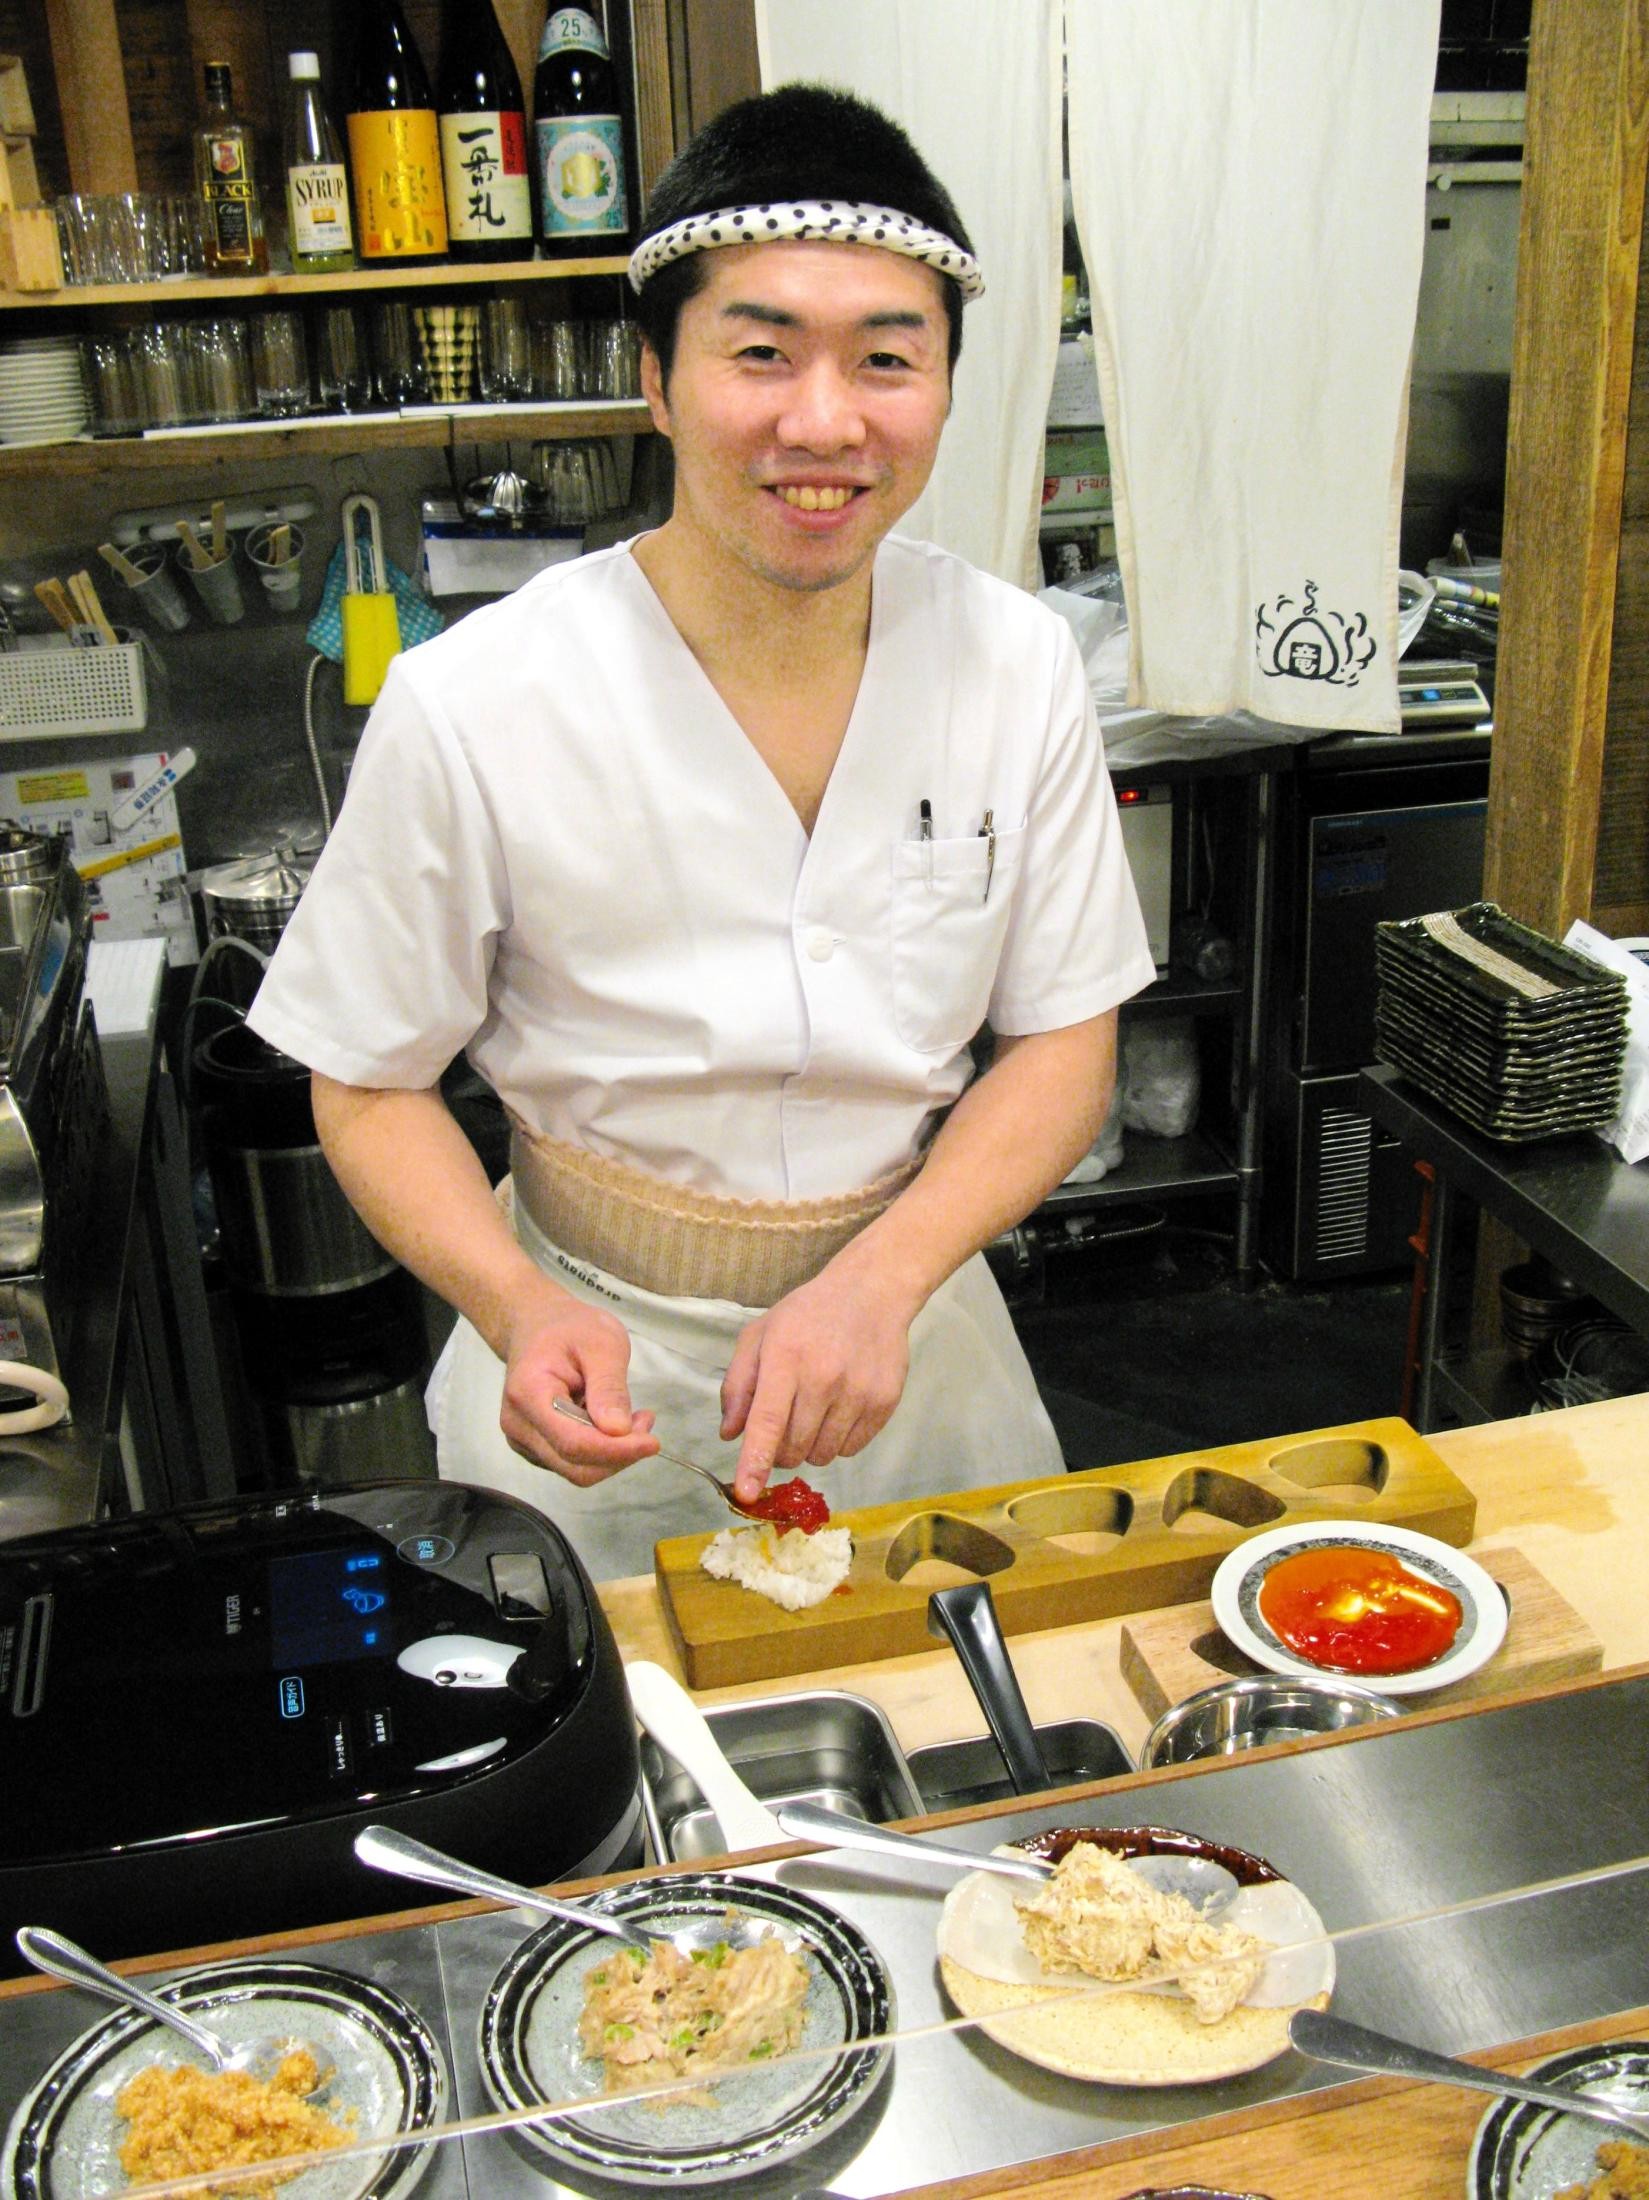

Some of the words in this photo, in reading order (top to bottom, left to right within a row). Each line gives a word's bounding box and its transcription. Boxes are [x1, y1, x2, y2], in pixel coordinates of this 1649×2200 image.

[561, 18, 581, 37] 25
[205, 183, 252, 199] BLACK
[295, 178, 344, 207] SYRUP
[1291, 643, 1321, 677] 竜
[226, 1594, 241, 1619] TIGER
